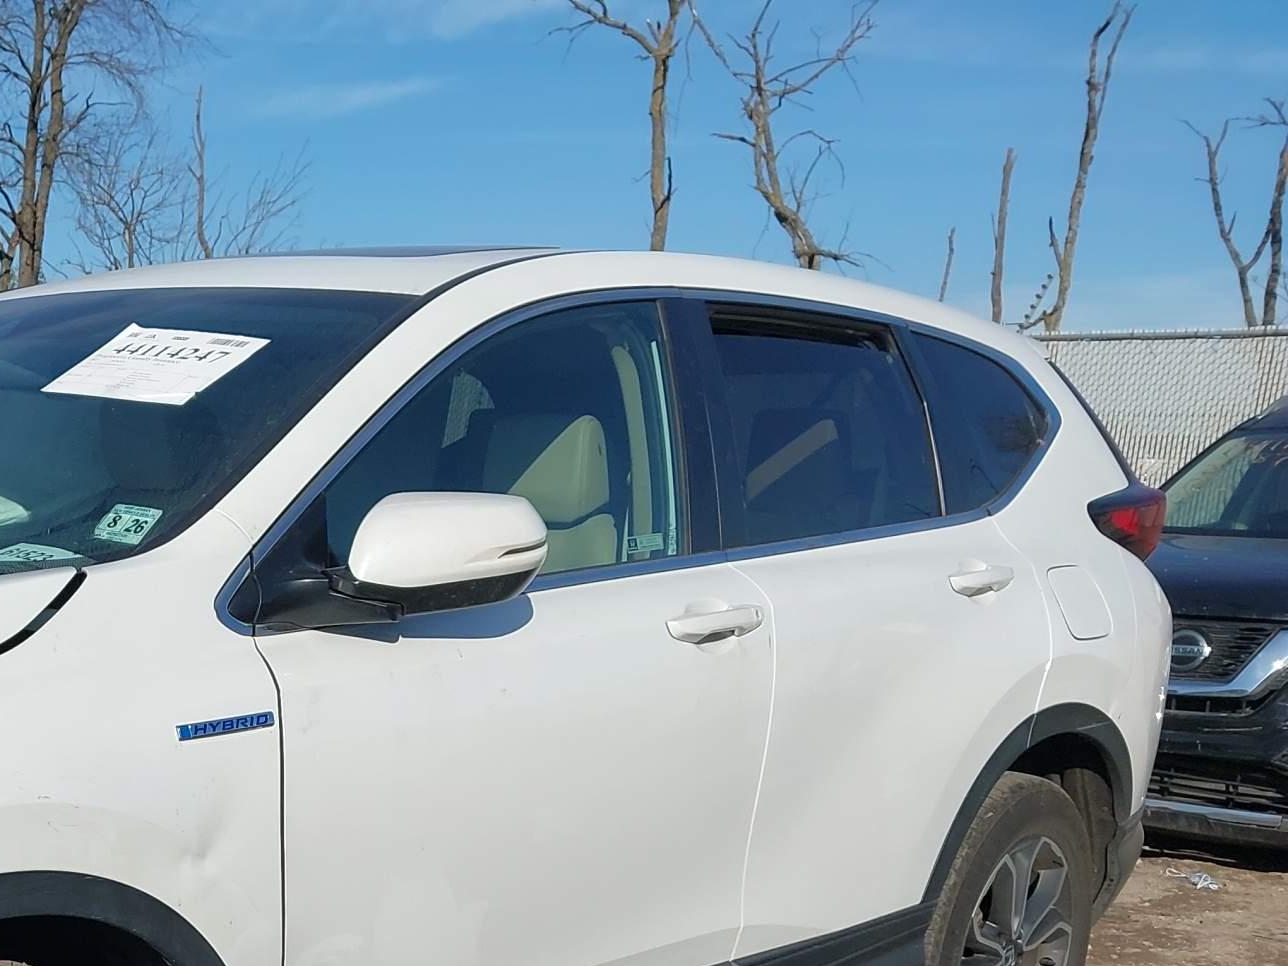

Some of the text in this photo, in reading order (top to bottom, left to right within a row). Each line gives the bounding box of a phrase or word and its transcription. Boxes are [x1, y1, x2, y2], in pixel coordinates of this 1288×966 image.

[113, 342, 233, 364] 44114247
[107, 515, 149, 534] 8 26
[193, 713, 270, 736] HYBRID
